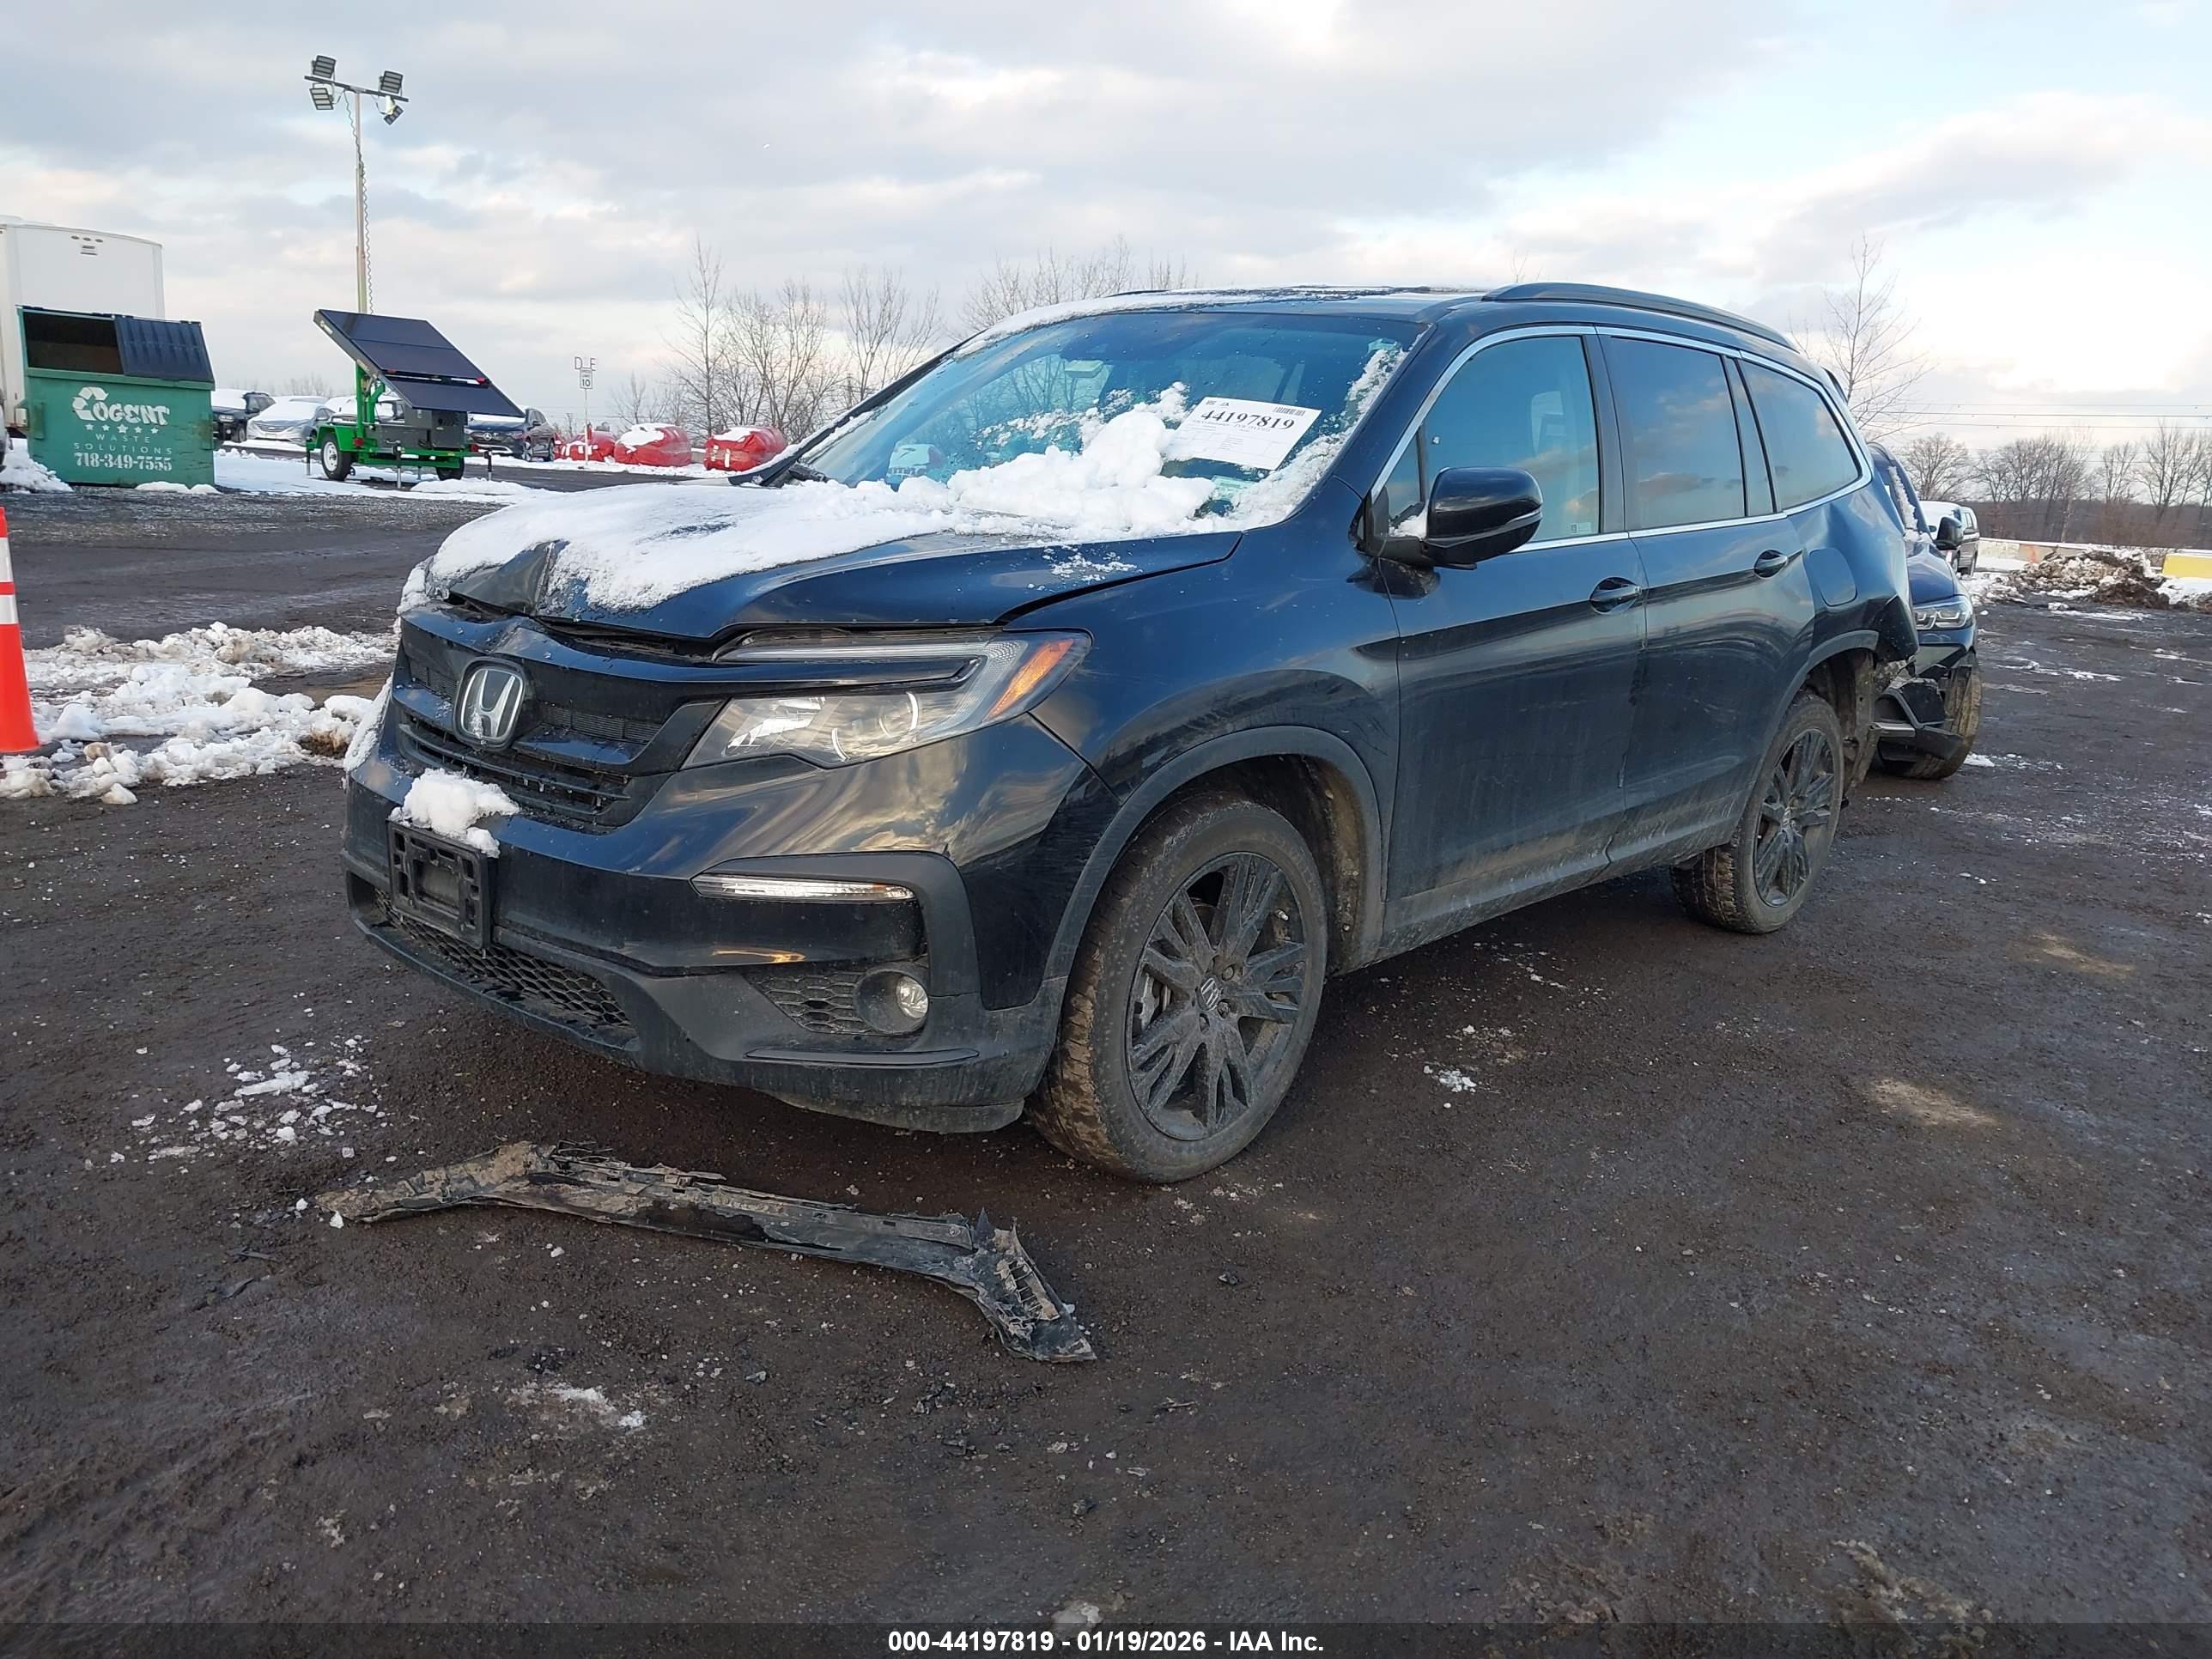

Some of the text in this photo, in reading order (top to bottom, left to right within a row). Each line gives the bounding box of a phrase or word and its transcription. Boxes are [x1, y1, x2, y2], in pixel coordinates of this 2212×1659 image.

[1201, 410, 1295, 429] 44197819
[95, 433, 150, 443] WASTE
[74, 442, 172, 455] SOLUTIONS
[74, 452, 172, 472] 718-349-7555
